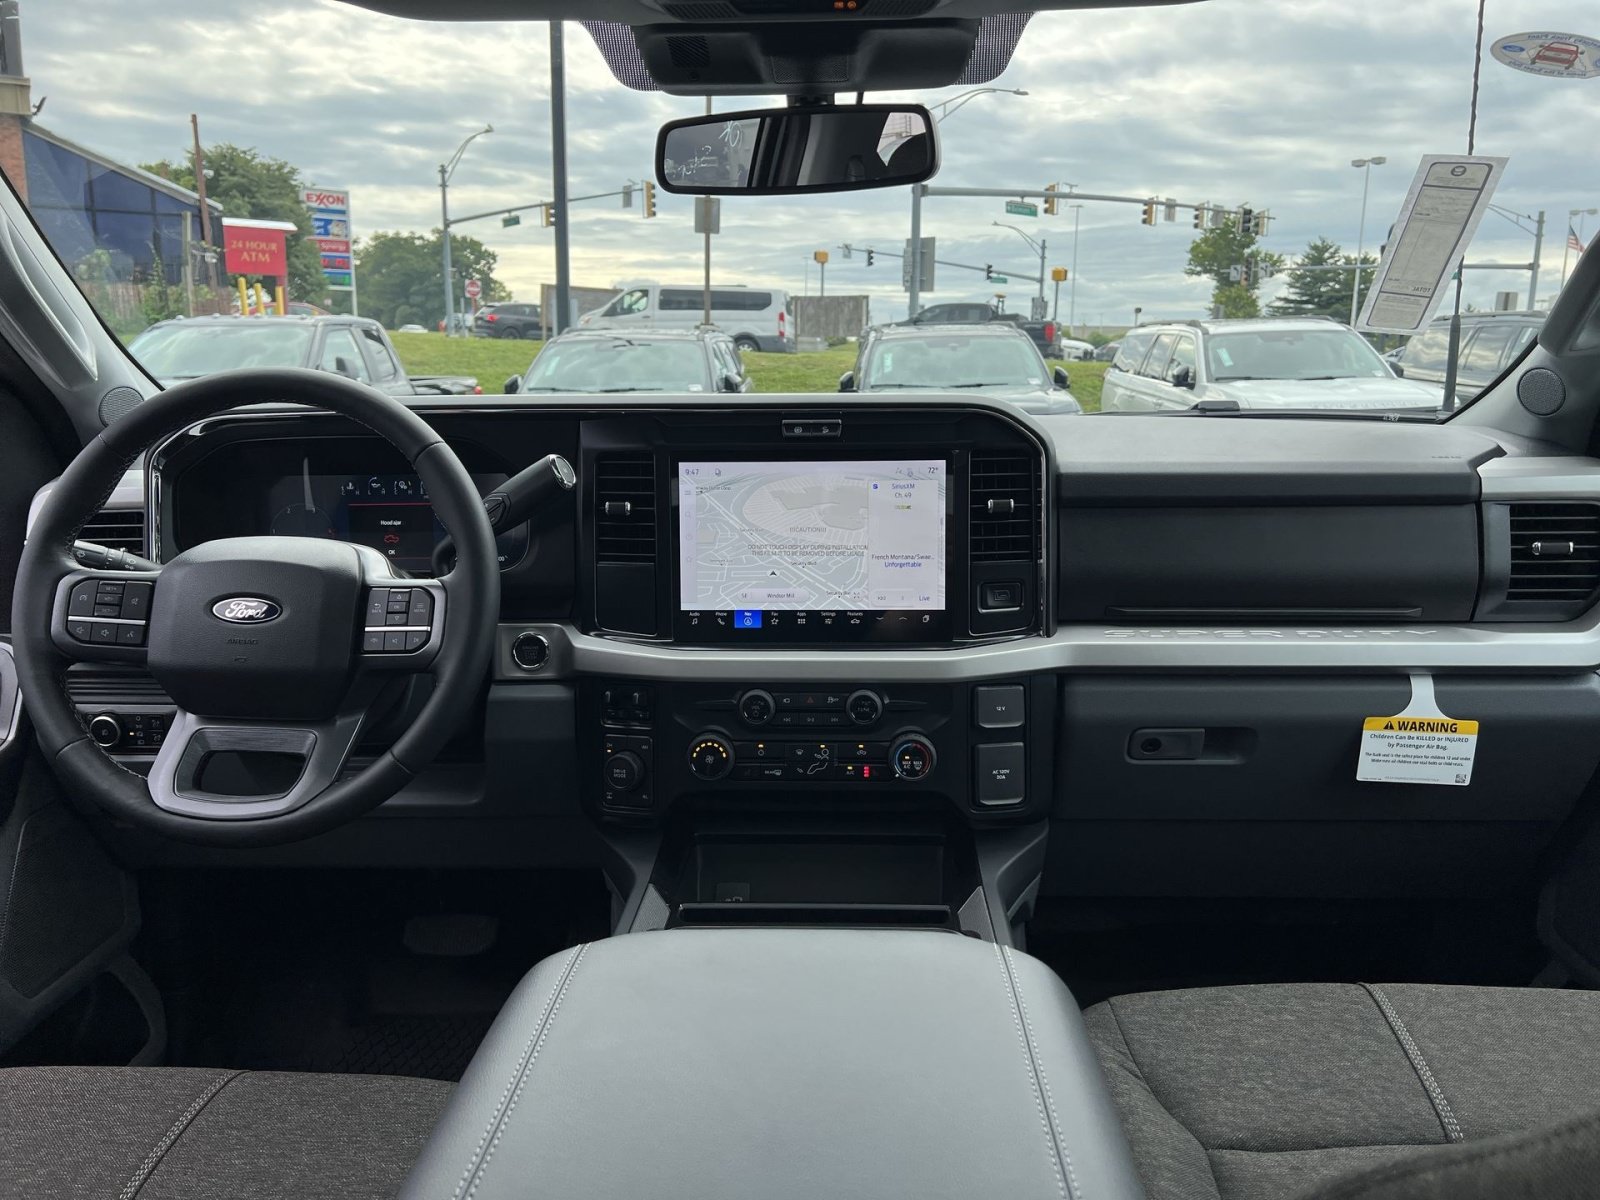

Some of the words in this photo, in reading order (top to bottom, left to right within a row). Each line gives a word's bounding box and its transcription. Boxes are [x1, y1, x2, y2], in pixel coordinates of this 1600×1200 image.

[306, 193, 346, 208] EXXON
[231, 240, 243, 249] 24
[246, 240, 279, 252] HOUR
[240, 252, 271, 263] ATM
[225, 600, 269, 618] Ford
[1103, 629, 1285, 638] SUPER
[1294, 629, 1438, 638] DUTY
[1397, 720, 1458, 734] WARNING
[1444, 736, 1469, 744] INJURED
[1396, 742, 1425, 750] Passenger
